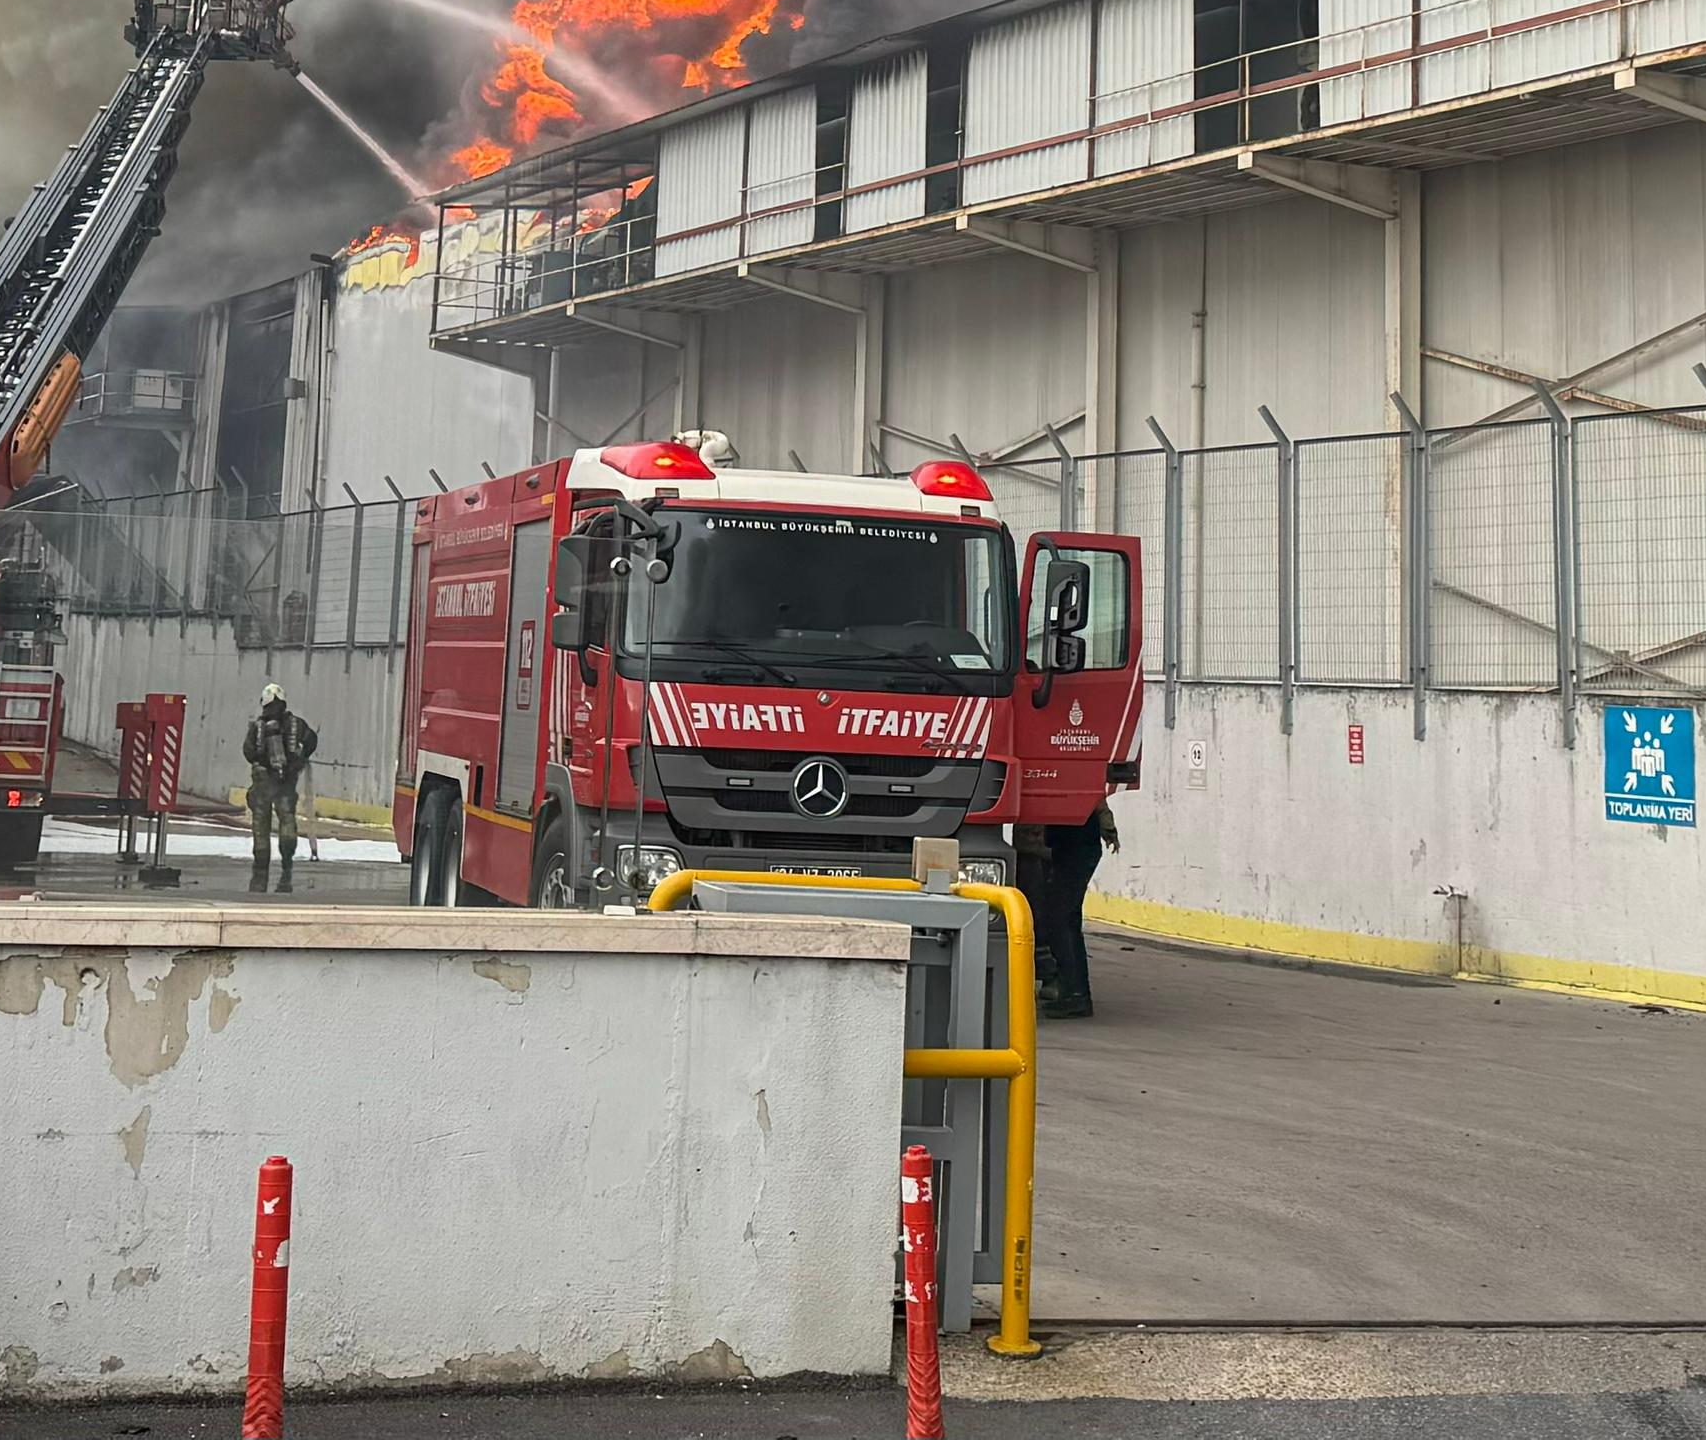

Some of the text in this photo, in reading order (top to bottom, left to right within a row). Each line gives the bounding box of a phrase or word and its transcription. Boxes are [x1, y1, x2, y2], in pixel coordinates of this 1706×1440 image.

[719, 518, 776, 531] İSTANBUL
[860, 527, 926, 540] BELEDİYESİ
[1609, 801, 1693, 822] TOPLANMA YERİ
